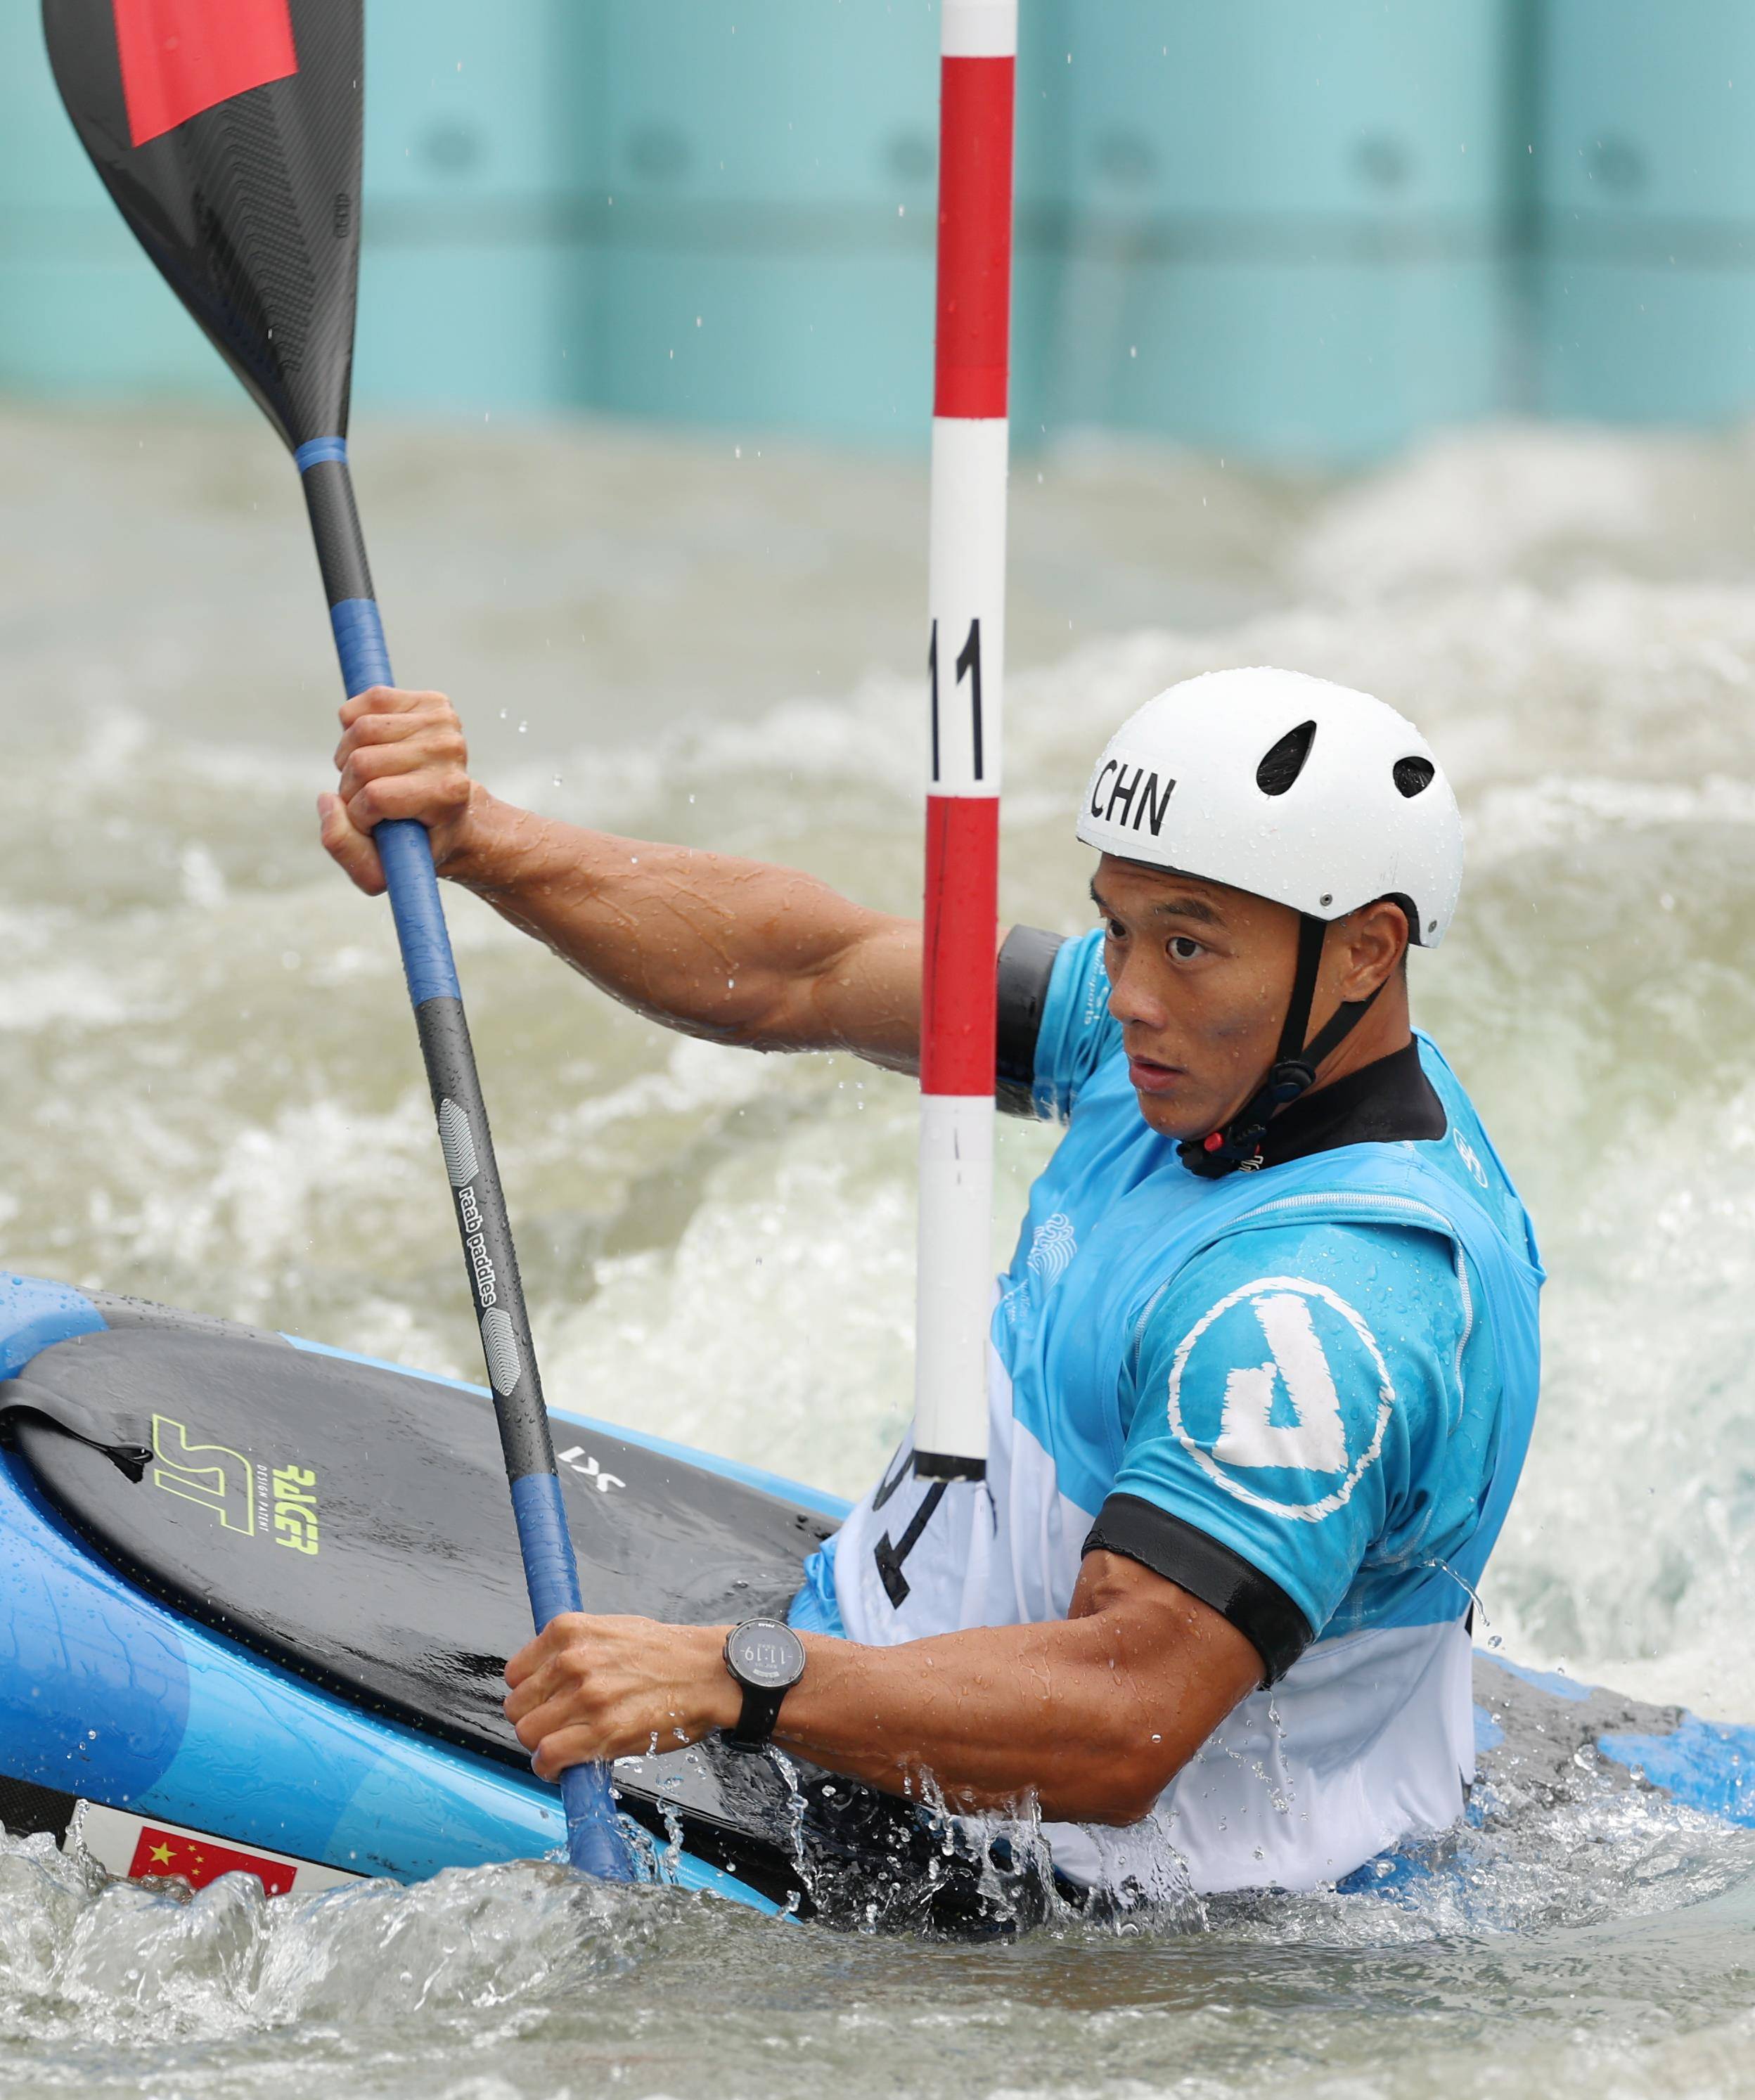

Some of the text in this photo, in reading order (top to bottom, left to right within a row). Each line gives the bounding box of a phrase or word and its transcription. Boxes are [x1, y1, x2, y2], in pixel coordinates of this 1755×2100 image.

[928, 619, 983, 781] 11
[1091, 759, 1177, 837] CHN
[458, 1186, 496, 1308] raab paddles
[152, 1413, 255, 1537] ST
[256, 1464, 269, 1532] DESIGN PATENT
[272, 1464, 319, 1555] RACER
[745, 1646, 786, 1666] 11:19
